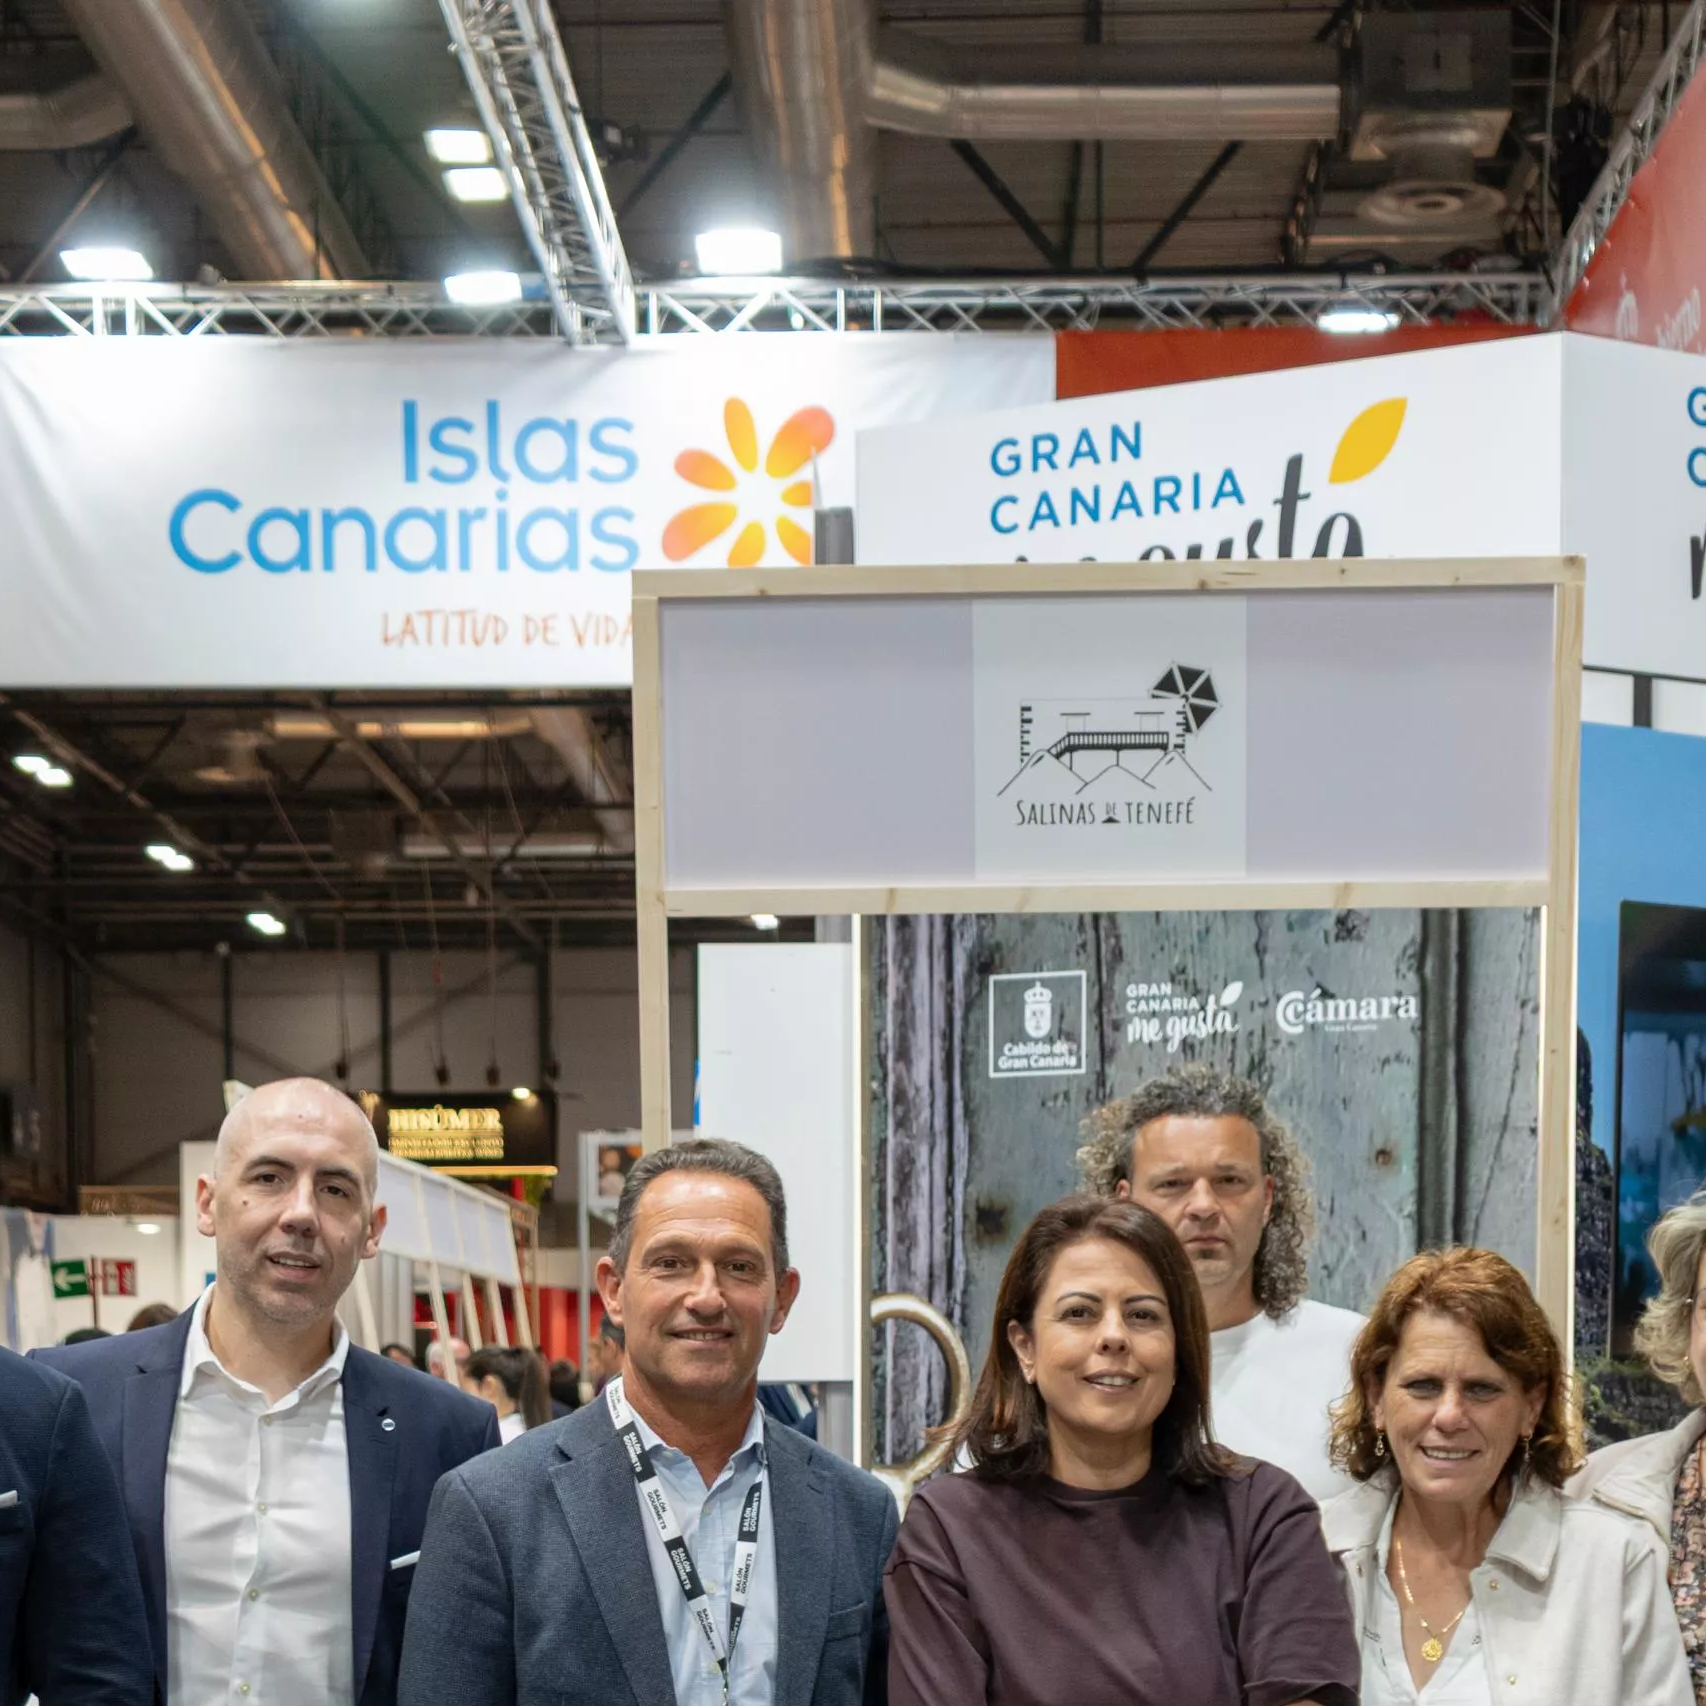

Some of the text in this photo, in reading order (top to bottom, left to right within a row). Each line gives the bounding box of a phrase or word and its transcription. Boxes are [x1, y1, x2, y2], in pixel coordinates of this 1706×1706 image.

[402, 398, 639, 485] Islas
[989, 421, 1143, 477] GRAN
[989, 467, 1246, 536] CANARIA
[168, 487, 640, 574] Canarias
[380, 607, 509, 648] LATITUD
[521, 612, 560, 647] DE
[1016, 799, 1096, 826] SALINAS
[1125, 796, 1197, 825] TENEFÉ
[1126, 983, 1172, 998] GRAN
[1126, 996, 1200, 1014] CANARIA
[1127, 994, 1241, 1053] me gusta
[998, 1053, 1078, 1070] Gran Canaria
[1003, 1041, 1051, 1057] Cabildo
